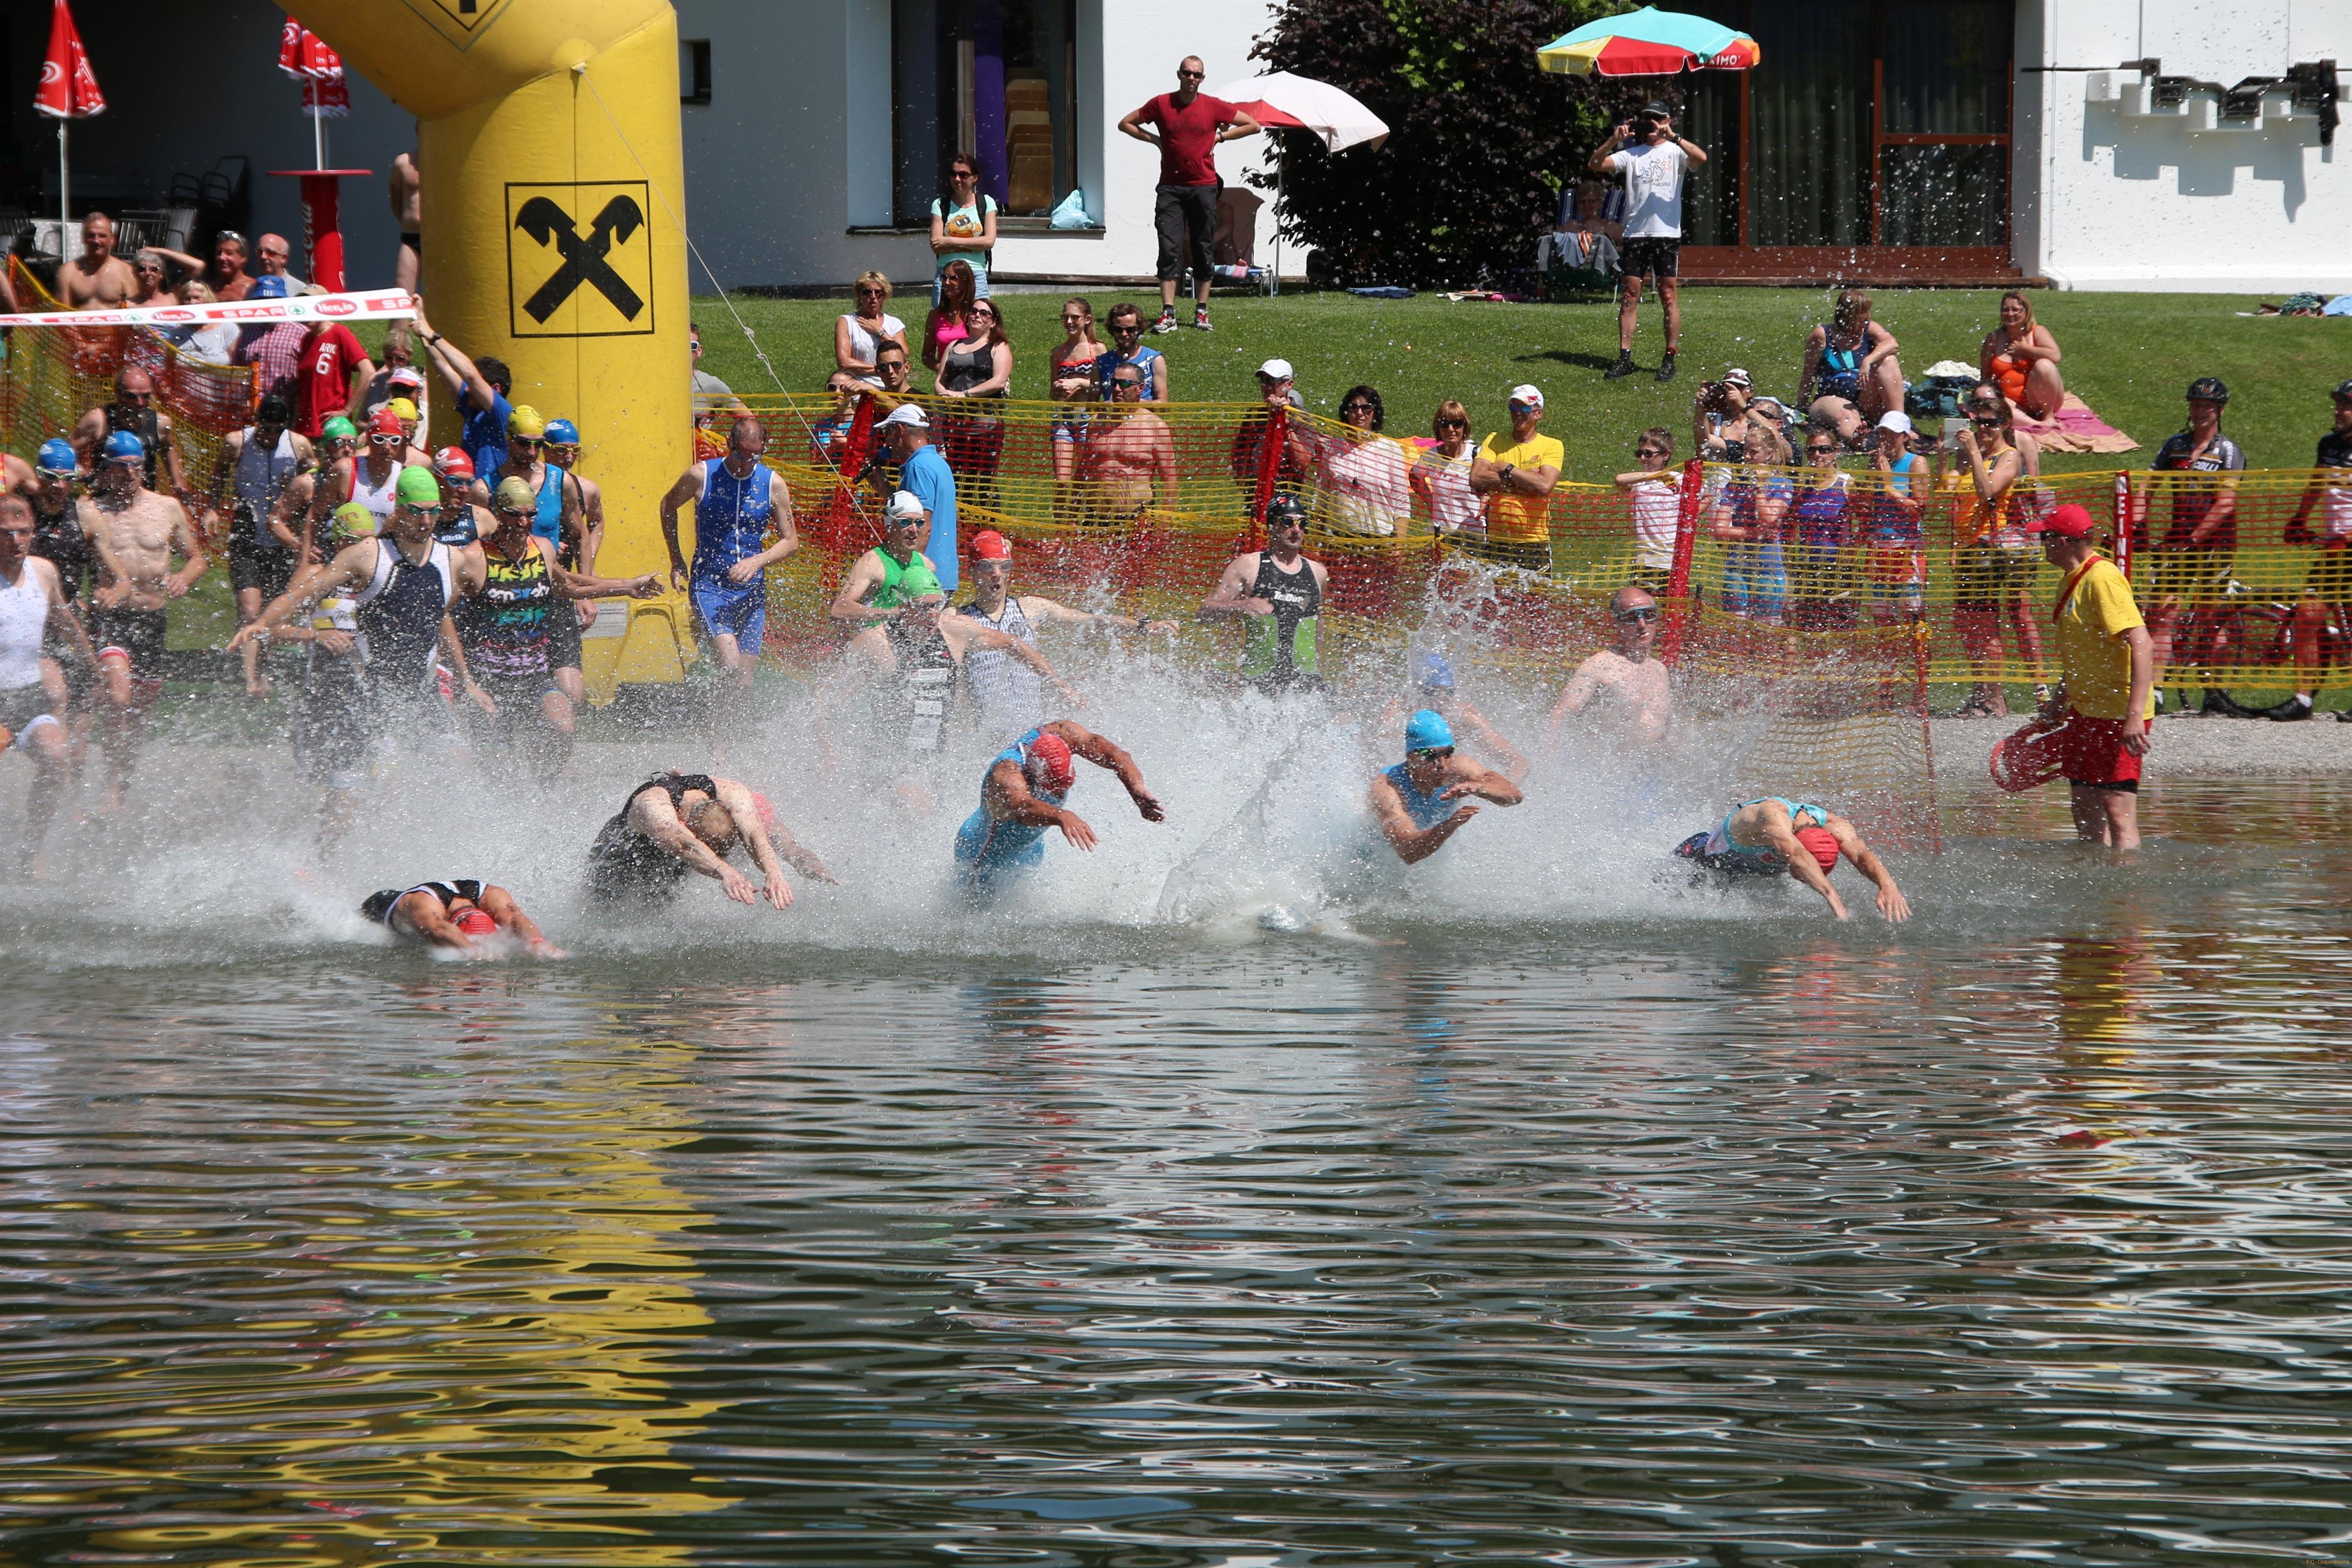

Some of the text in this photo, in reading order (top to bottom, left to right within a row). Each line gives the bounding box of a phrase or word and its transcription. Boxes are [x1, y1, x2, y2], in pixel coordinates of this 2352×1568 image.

[222, 307, 285, 317] SPAR
[318, 302, 353, 312] Hervis
[57, 313, 121, 323] SPAR
[155, 311, 192, 320] Hervis
[316, 354, 331, 375] 6
